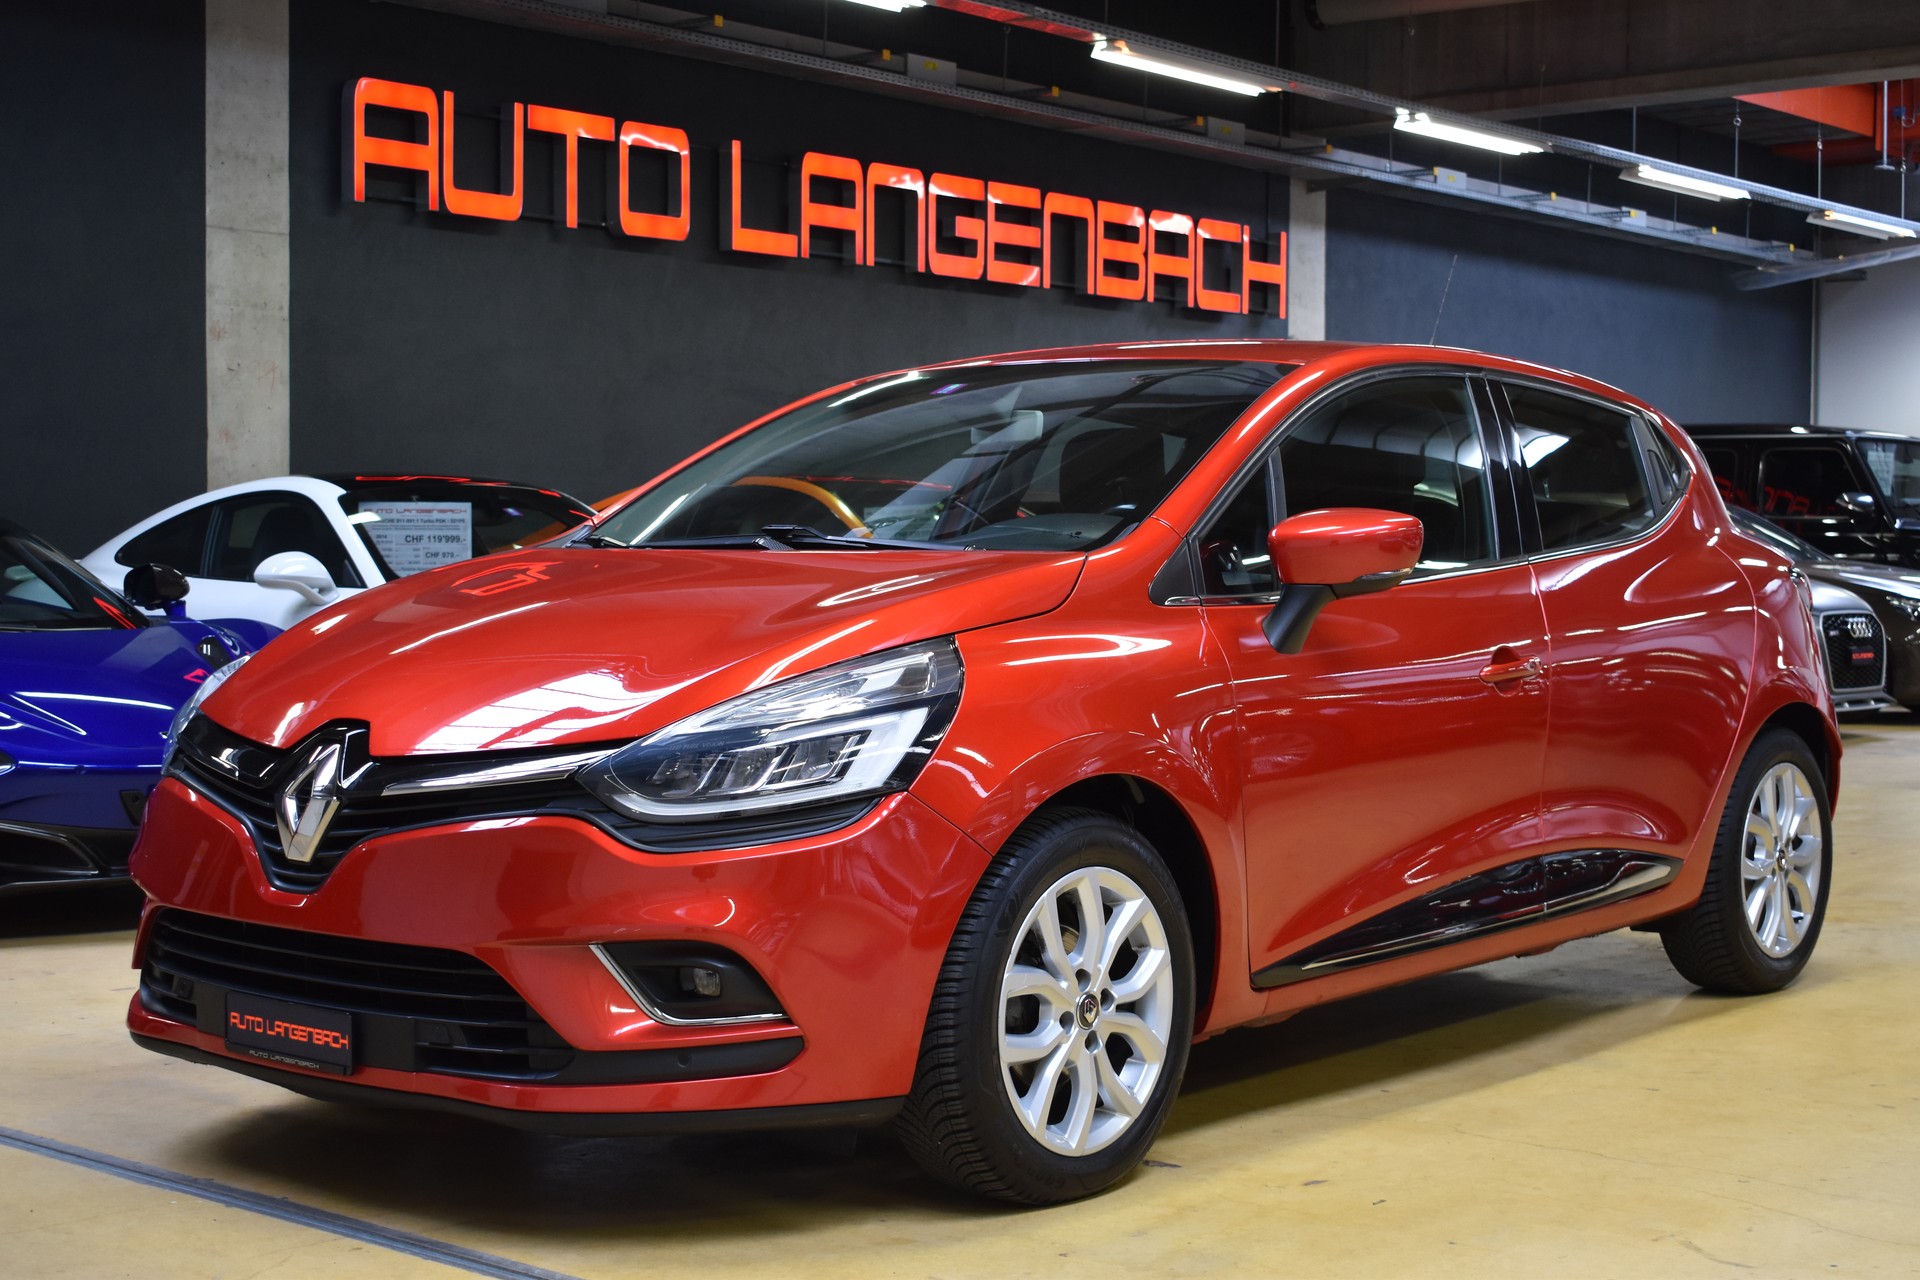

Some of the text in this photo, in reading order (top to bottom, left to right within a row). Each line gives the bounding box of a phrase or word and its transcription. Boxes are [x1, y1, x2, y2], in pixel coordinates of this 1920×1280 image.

[354, 76, 1288, 320] AUTO LANGENBACH
[404, 535, 424, 544] CHF
[427, 534, 466, 544] 119'999.-
[229, 1011, 349, 1050] AUTO LANGENBACH
[249, 1049, 320, 1070] AUTO LANGENBACH
